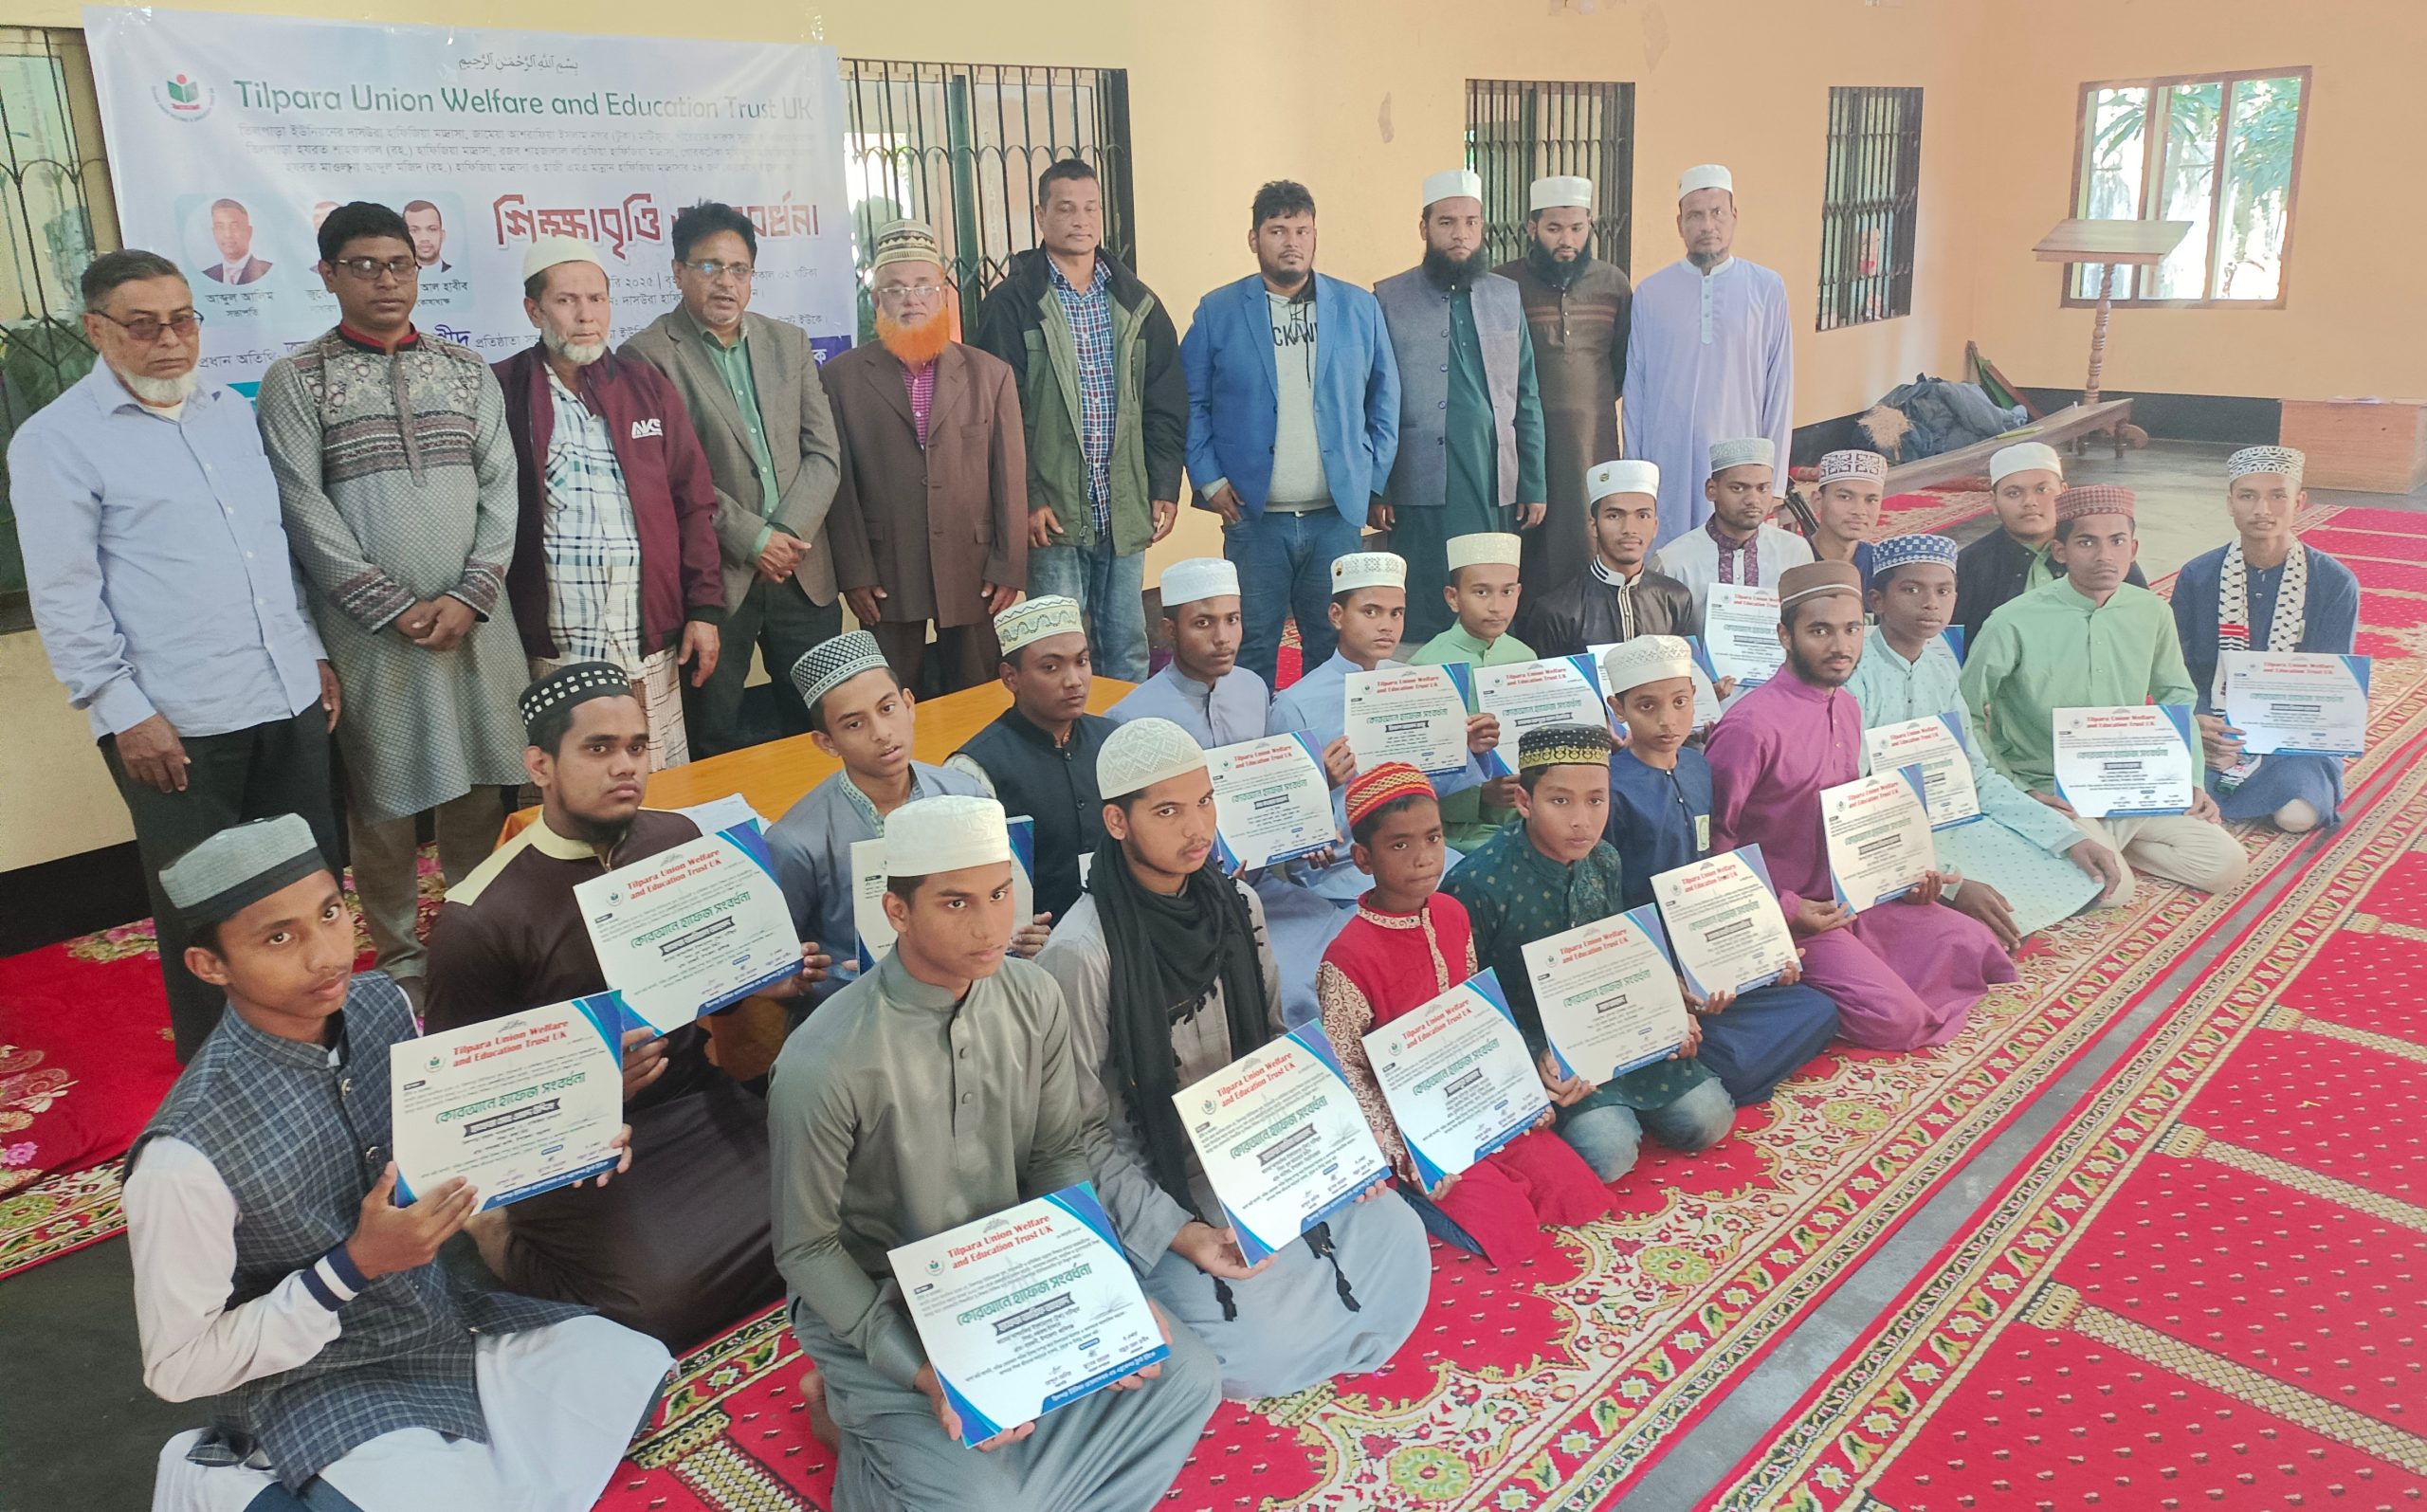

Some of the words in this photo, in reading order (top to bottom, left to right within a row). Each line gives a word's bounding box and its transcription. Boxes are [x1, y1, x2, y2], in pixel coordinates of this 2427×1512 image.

[233, 79, 342, 115] Tilpara
[349, 83, 434, 113] Union
[440, 87, 543, 116] Welfare
[551, 92, 599, 117] and
[606, 92, 720, 119] Education
[724, 96, 776, 120] Trust
[782, 97, 813, 120] UK
[493, 192, 661, 261] শিক্ষাবৃত্তি
[625, 277, 653, 289] ২০২৫
[628, 874, 659, 889] Tilpara
[660, 863, 686, 877] Union
[687, 850, 720, 865] Welfare
[630, 888, 646, 900] and
[647, 873, 686, 893] Education
[687, 864, 708, 876] Trust
[709, 859, 721, 867] UK
[630, 920, 680, 948] কোরআনে
[679, 906, 713, 928] হাফেজ
[713, 891, 751, 914] সংবর্ধনা
[453, 1041, 492, 1055] Tilpara
[495, 1031, 526, 1045] Union
[529, 1021, 569, 1035] Welfare
[453, 1055, 471, 1067] and
[474, 1044, 522, 1062] Education
[525, 1035, 550, 1047] Trust
[553, 1031, 567, 1040] UK
[1216, 1080, 1244, 1097] Tilpara
[1243, 1067, 1266, 1083] Union
[1265, 1053, 1292, 1070] Welfare
[1222, 1095, 1234, 1107] and
[1234, 1078, 1267, 1100] Education
[1267, 1067, 1285, 1082] Trust
[1284, 1063, 1296, 1071] UK
[435, 1098, 496, 1123] কোরআনে
[499, 1085, 538, 1106] হাফেজ
[541, 1071, 586, 1094] সংবর্ধনা
[947, 1241, 983, 1258] Tilpara
[983, 1230, 1013, 1245] Union
[1013, 1215, 1049, 1233] Welfare
[953, 1256, 969, 1269] and
[970, 1241, 1013, 1262] Education
[1014, 1230, 1038, 1245] Trust
[1038, 1226, 1053, 1235] UK
[957, 1295, 1013, 1326] কোরআনে
[1011, 1280, 1050, 1304] হাফেজ
[1049, 1263, 1092, 1288] সংবর্ধনা
